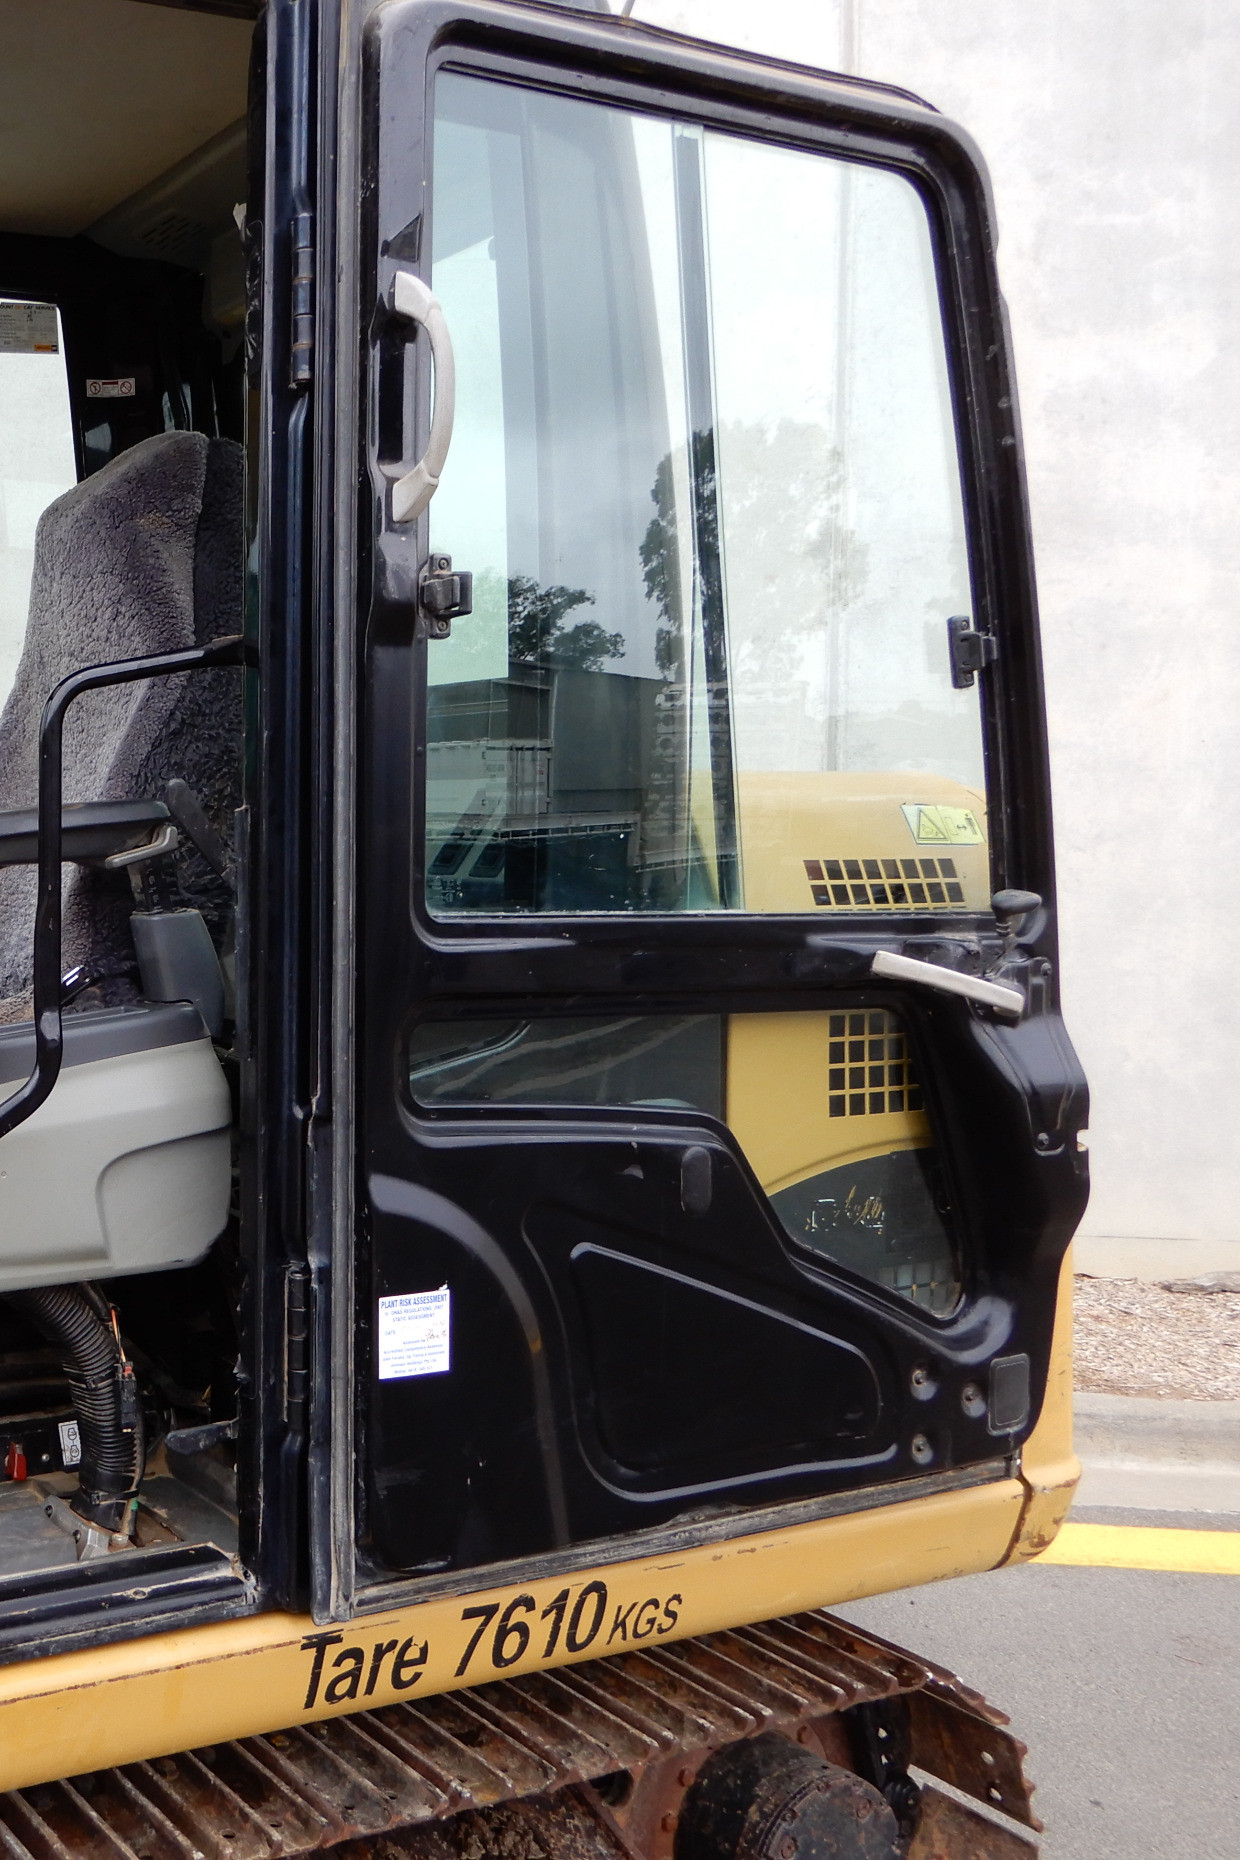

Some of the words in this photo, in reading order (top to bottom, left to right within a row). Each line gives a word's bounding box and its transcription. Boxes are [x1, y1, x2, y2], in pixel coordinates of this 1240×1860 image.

[381, 1300, 398, 1309] PLANT
[400, 1298, 412, 1307] RISK
[413, 1294, 447, 1305] ASSESSMENT
[301, 1631, 429, 1710] Tare
[453, 1580, 608, 1678] 7610
[606, 1593, 683, 1645] KGS
